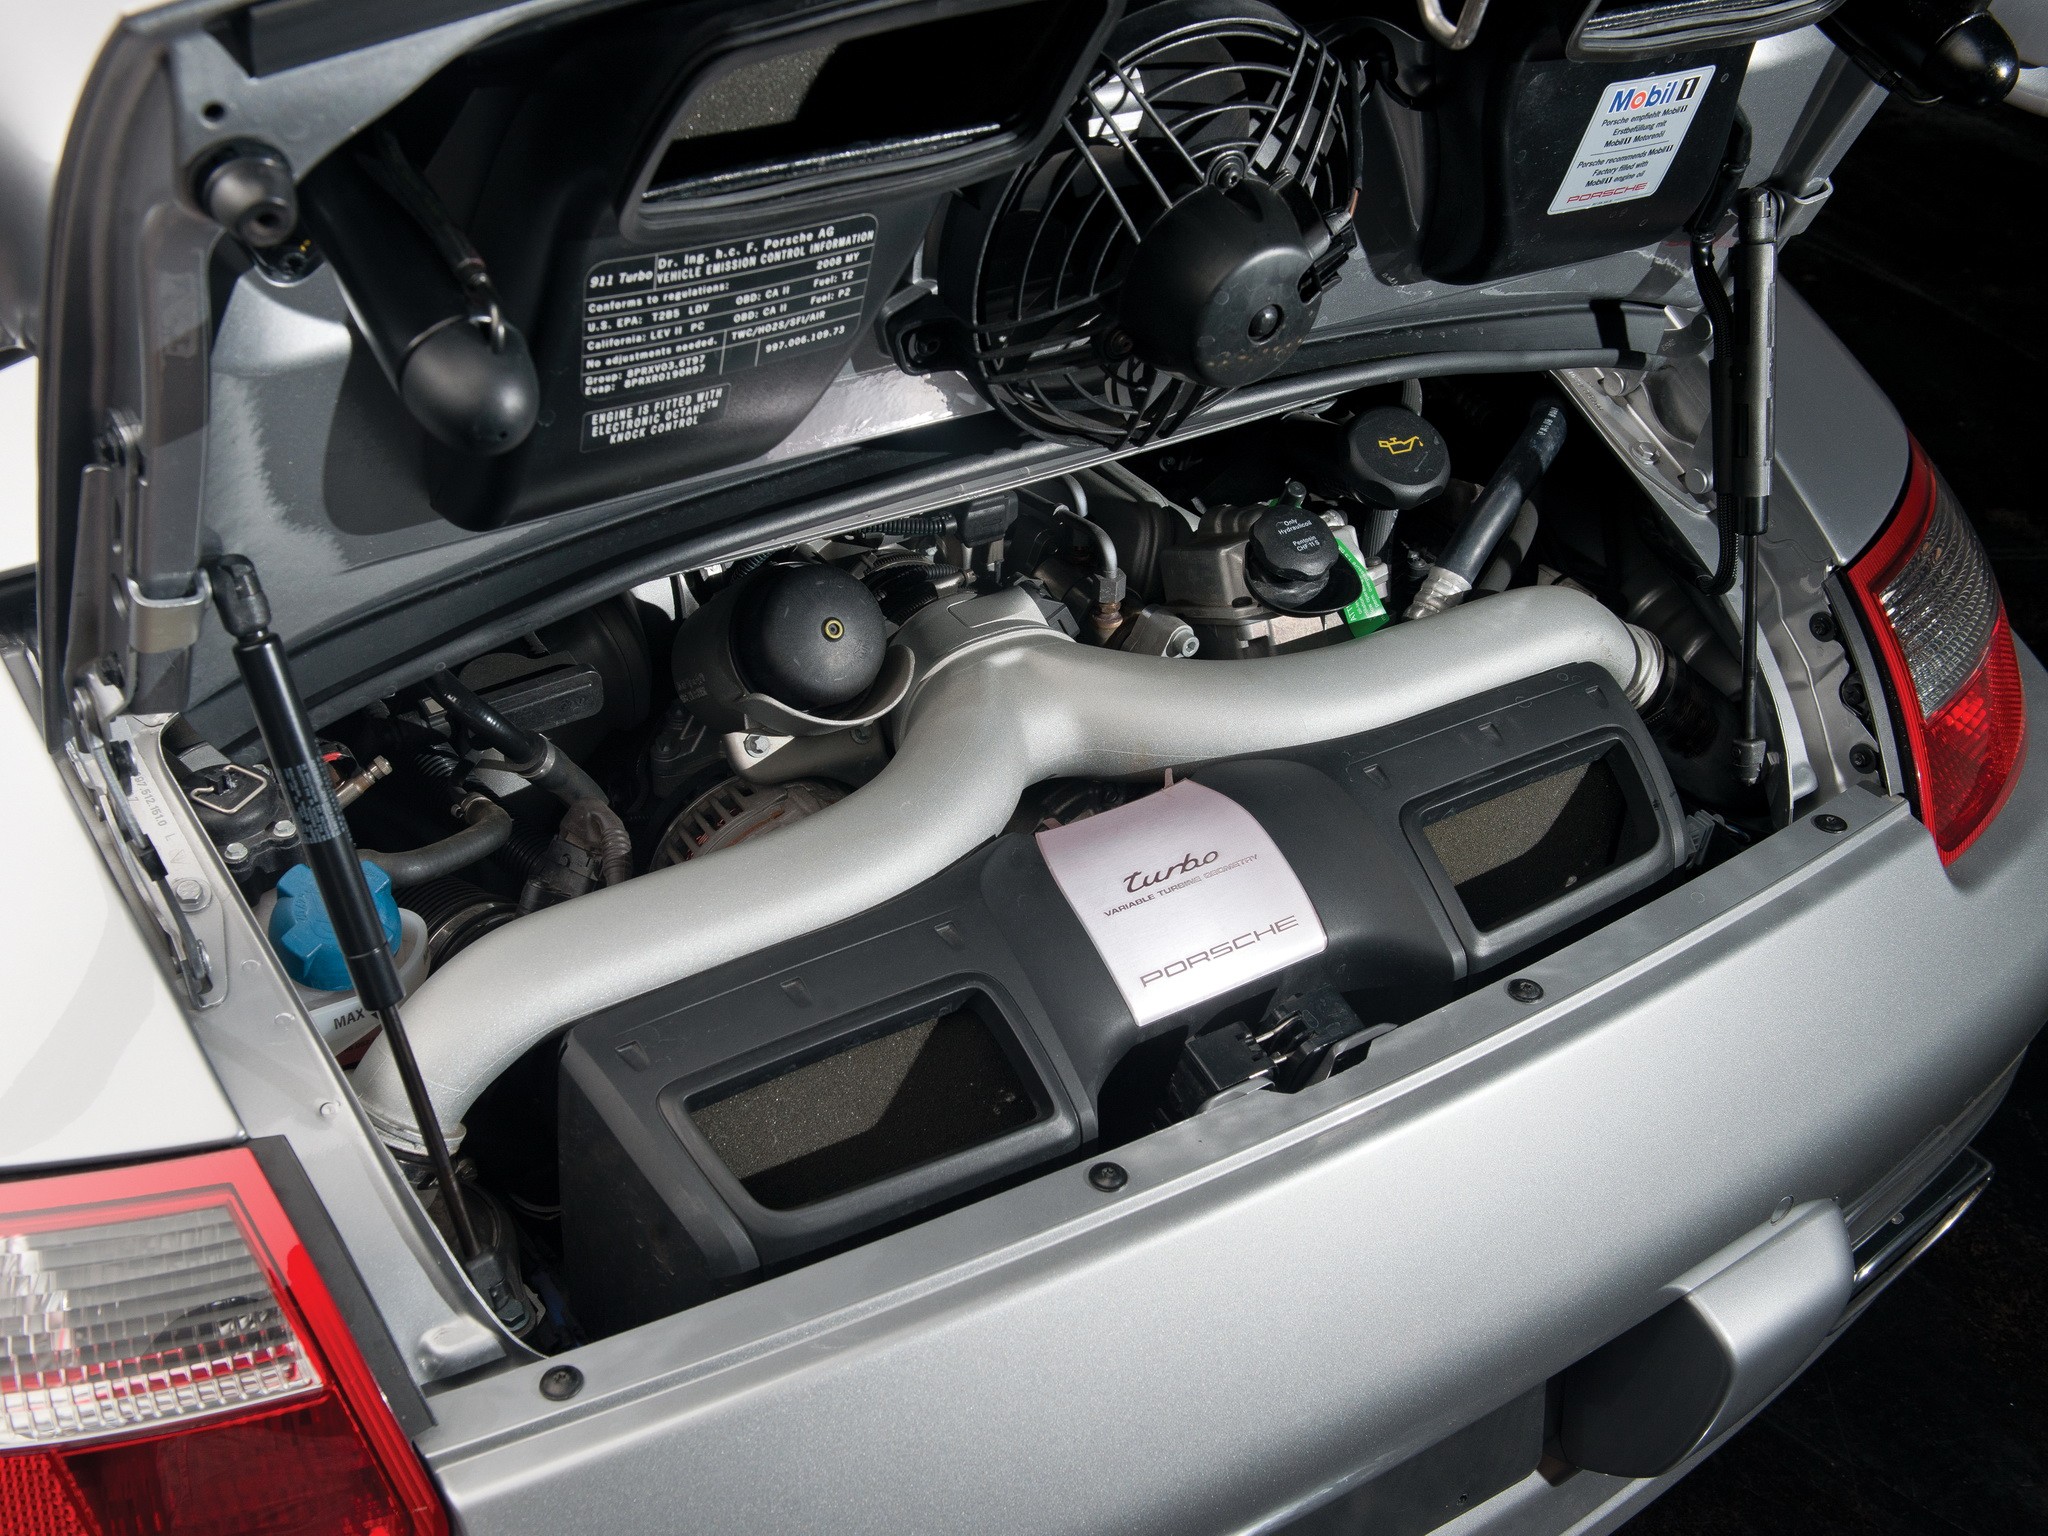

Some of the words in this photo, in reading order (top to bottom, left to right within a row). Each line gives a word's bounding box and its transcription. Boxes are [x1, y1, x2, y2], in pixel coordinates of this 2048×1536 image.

[1609, 81, 1678, 113] Mobil
[1678, 77, 1699, 100] 1
[1601, 117, 1629, 127] Porsche
[1631, 111, 1662, 122] empfiehlt
[1655, 120, 1667, 128] mit
[1633, 130, 1666, 143] Motorenöl
[1577, 158, 1605, 168] Porsche
[1605, 150, 1648, 164] recommends
[1592, 166, 1618, 177] Factory
[1618, 162, 1635, 172] filled
[1635, 160, 1649, 169] with
[1613, 172, 1635, 182] engine
[1636, 170, 1646, 178] oil
[1566, 182, 1648, 203] PORSCHE
[656, 266, 702, 285] VEHICLE
[705, 255, 757, 277] EMISSION
[760, 245, 806, 265] CONTROL
[809, 229, 875, 255] INFORMATION
[657, 257, 679, 271] Dr.
[684, 253, 710, 266] Ing.
[715, 247, 741, 260] h.c.
[746, 241, 759, 255] F.
[763, 231, 814, 251] Porsche
[817, 225, 835, 239] AG
[815, 256, 843, 271] 2008
[845, 251, 861, 263] MY
[589, 274, 614, 289] 911
[619, 269, 654, 284] Turbo
[735, 291, 762, 306] OBD:
[765, 287, 779, 300] CA
[781, 285, 791, 296] II
[812, 274, 838, 288] Fuel:
[841, 269, 855, 282] T2
[587, 297, 643, 314] Conforms
[646, 295, 659, 305] to
[662, 281, 730, 302] regulations:
[732, 310, 760, 324] OBD:
[762, 305, 777, 317] CA
[779, 302, 788, 313] II
[809, 291, 835, 305] Fuel:
[837, 286, 852, 299] P2
[587, 320, 612, 333] U.S.
[616, 315, 643, 329] EPA:
[688, 302, 710, 316] LDV
[586, 333, 647, 352] California:
[650, 327, 671, 341] LEV
[674, 325, 683, 336] II
[690, 321, 706, 333] PC
[585, 358, 602, 370] No
[604, 346, 673, 367] adjustments
[675, 336, 718, 353] needed.
[584, 372, 623, 386] Group:
[584, 383, 616, 397] Evap:
[591, 406, 634, 426] ENGINE
[637, 403, 650, 417] IS
[653, 394, 693, 413] FITTED
[696, 387, 723, 403] WITH
[591, 412, 661, 438] ELECTRONIC
[609, 426, 647, 445] KNOCK
[650, 415, 699, 436] CONTROL
[1283, 518, 1298, 527] Only
[1103, 893, 1156, 917] VARIABLE
[1156, 875, 1203, 897] TURBINE
[1203, 853, 1258, 879] GEOMETRY
[1123, 850, 1219, 893] turbo
[1139, 915, 1299, 988] PORSCHE
[333, 1008, 365, 1030] MAX
